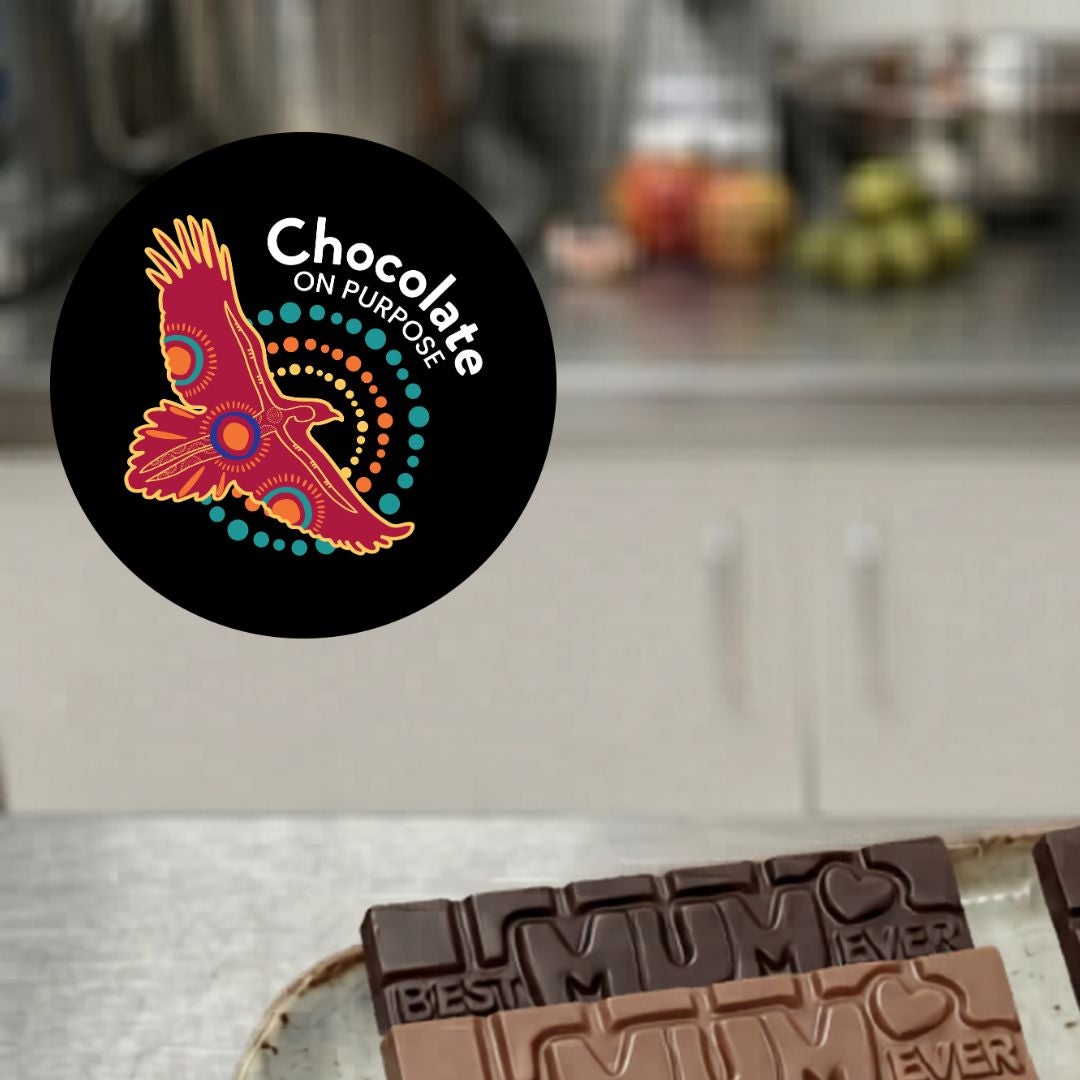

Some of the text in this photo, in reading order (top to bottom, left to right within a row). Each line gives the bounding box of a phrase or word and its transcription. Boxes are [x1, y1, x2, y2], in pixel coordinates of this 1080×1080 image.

[396, 882, 962, 1022] BEST MUM EVER
